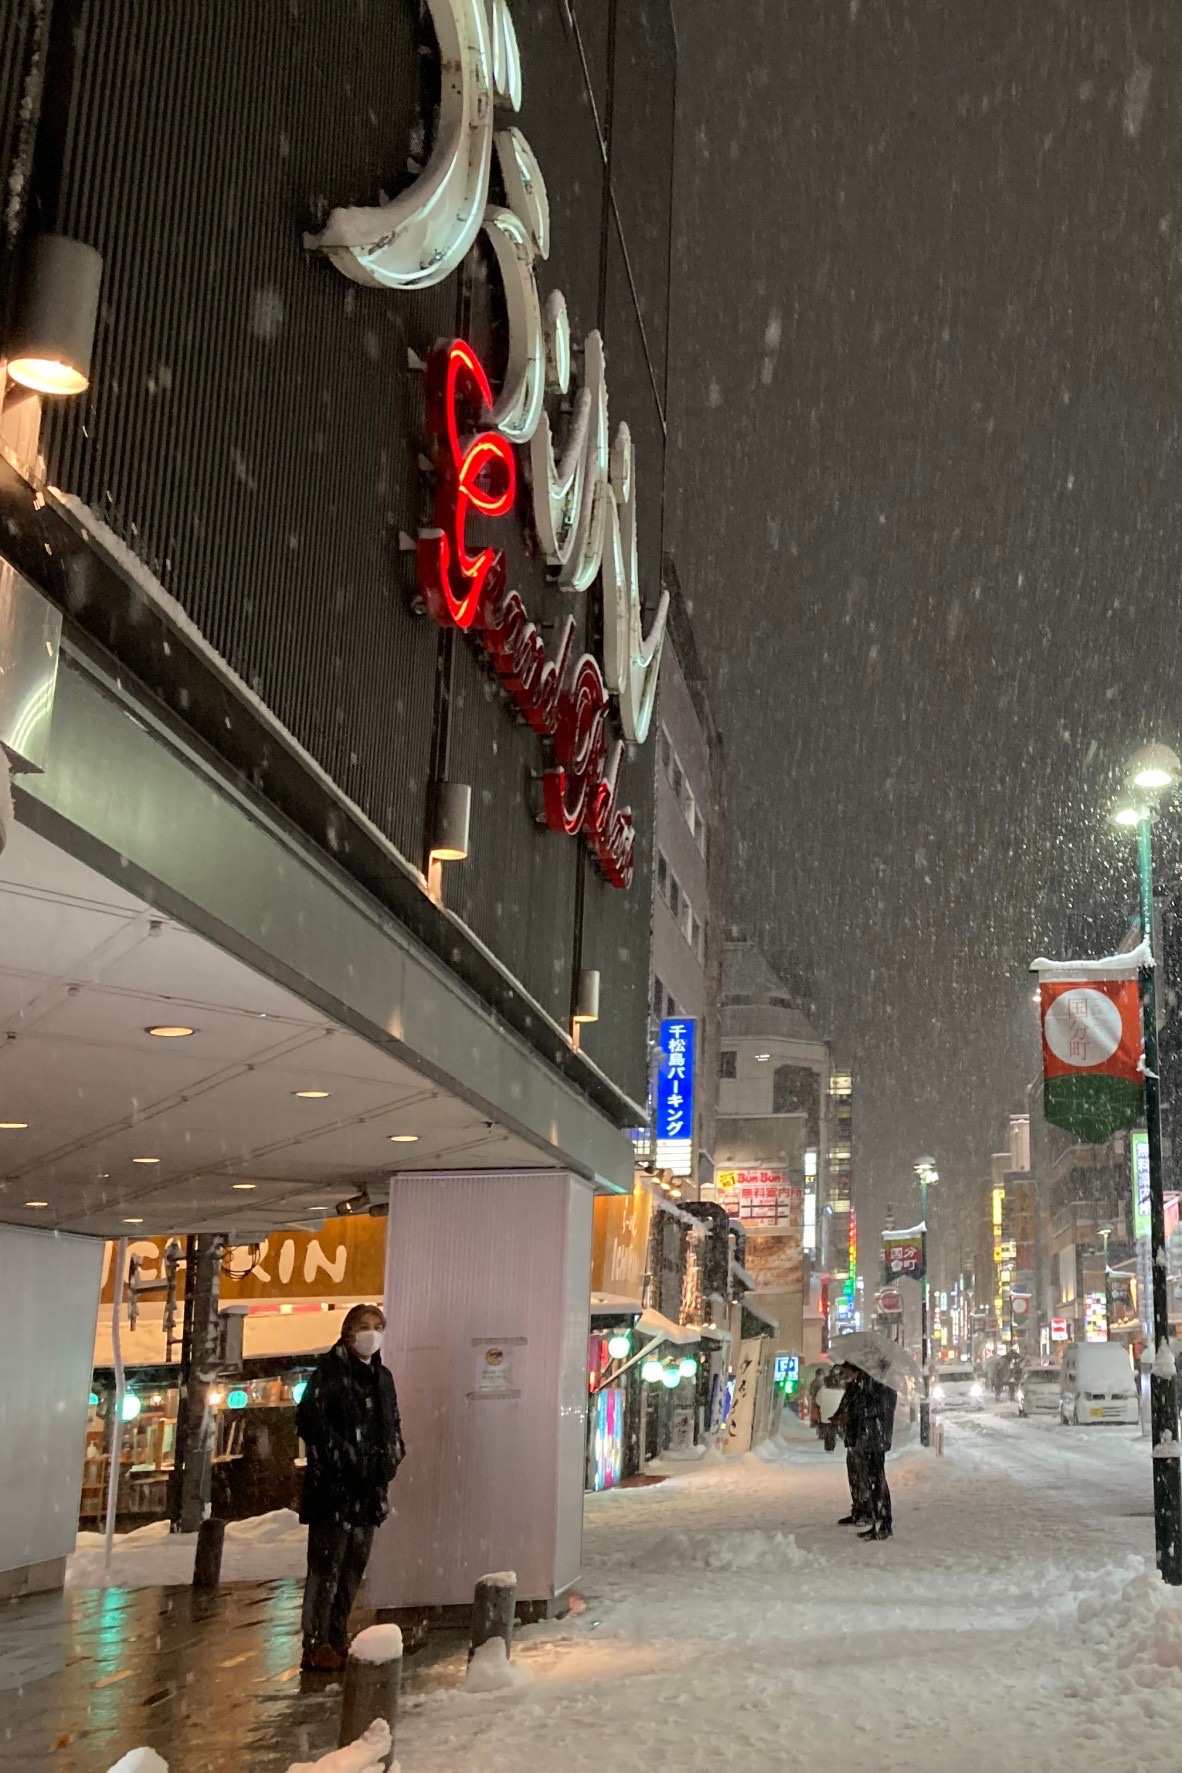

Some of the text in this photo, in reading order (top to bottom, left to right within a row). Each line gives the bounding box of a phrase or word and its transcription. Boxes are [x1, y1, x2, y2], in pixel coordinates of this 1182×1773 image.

[1067, 997, 1091, 1061] 国分町
[665, 1024, 687, 1137] 千松島パーキング
[741, 1187, 802, 1199] 無料案内所
